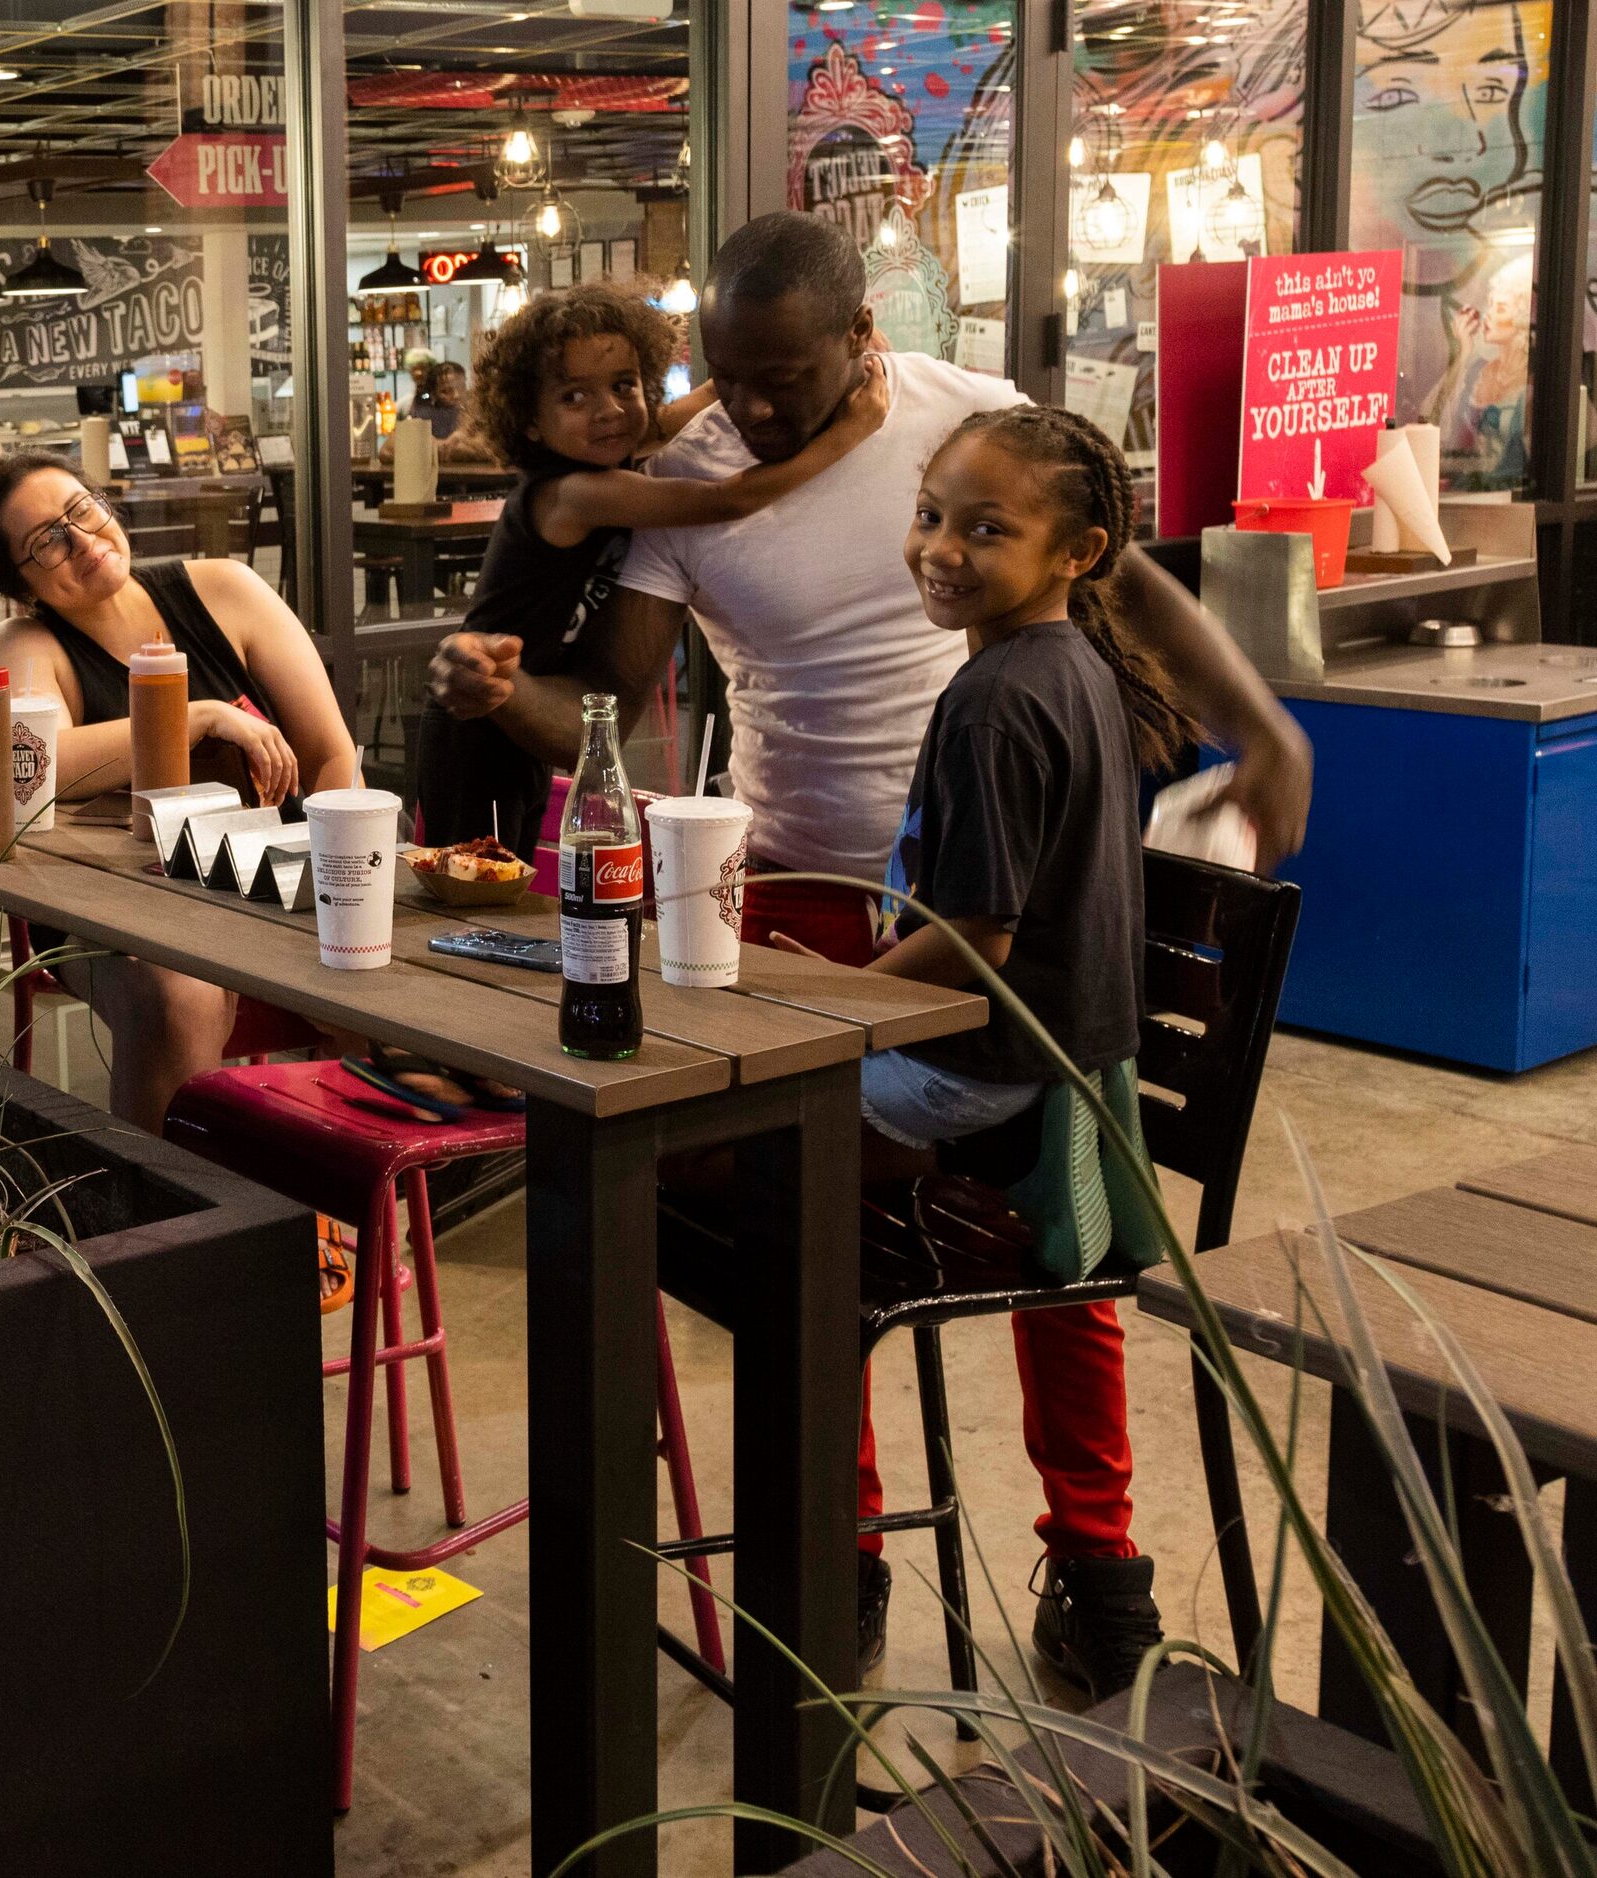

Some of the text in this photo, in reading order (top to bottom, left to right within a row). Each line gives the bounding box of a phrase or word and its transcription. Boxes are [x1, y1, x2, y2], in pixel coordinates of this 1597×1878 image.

[1275, 265, 1375, 297] this ain't yo
[1, 330, 20, 364] A
[26, 312, 98, 366] NEW
[102, 275, 204, 356] TACO
[1269, 286, 1380, 324] mama's house!
[69, 361, 111, 381] EVERY
[1268, 342, 1378, 383] CLEAN UP
[1286, 376, 1337, 402] AFTER
[1250, 393, 1389, 441] YOURSELF!
[564, 892, 584, 903] 500ml
